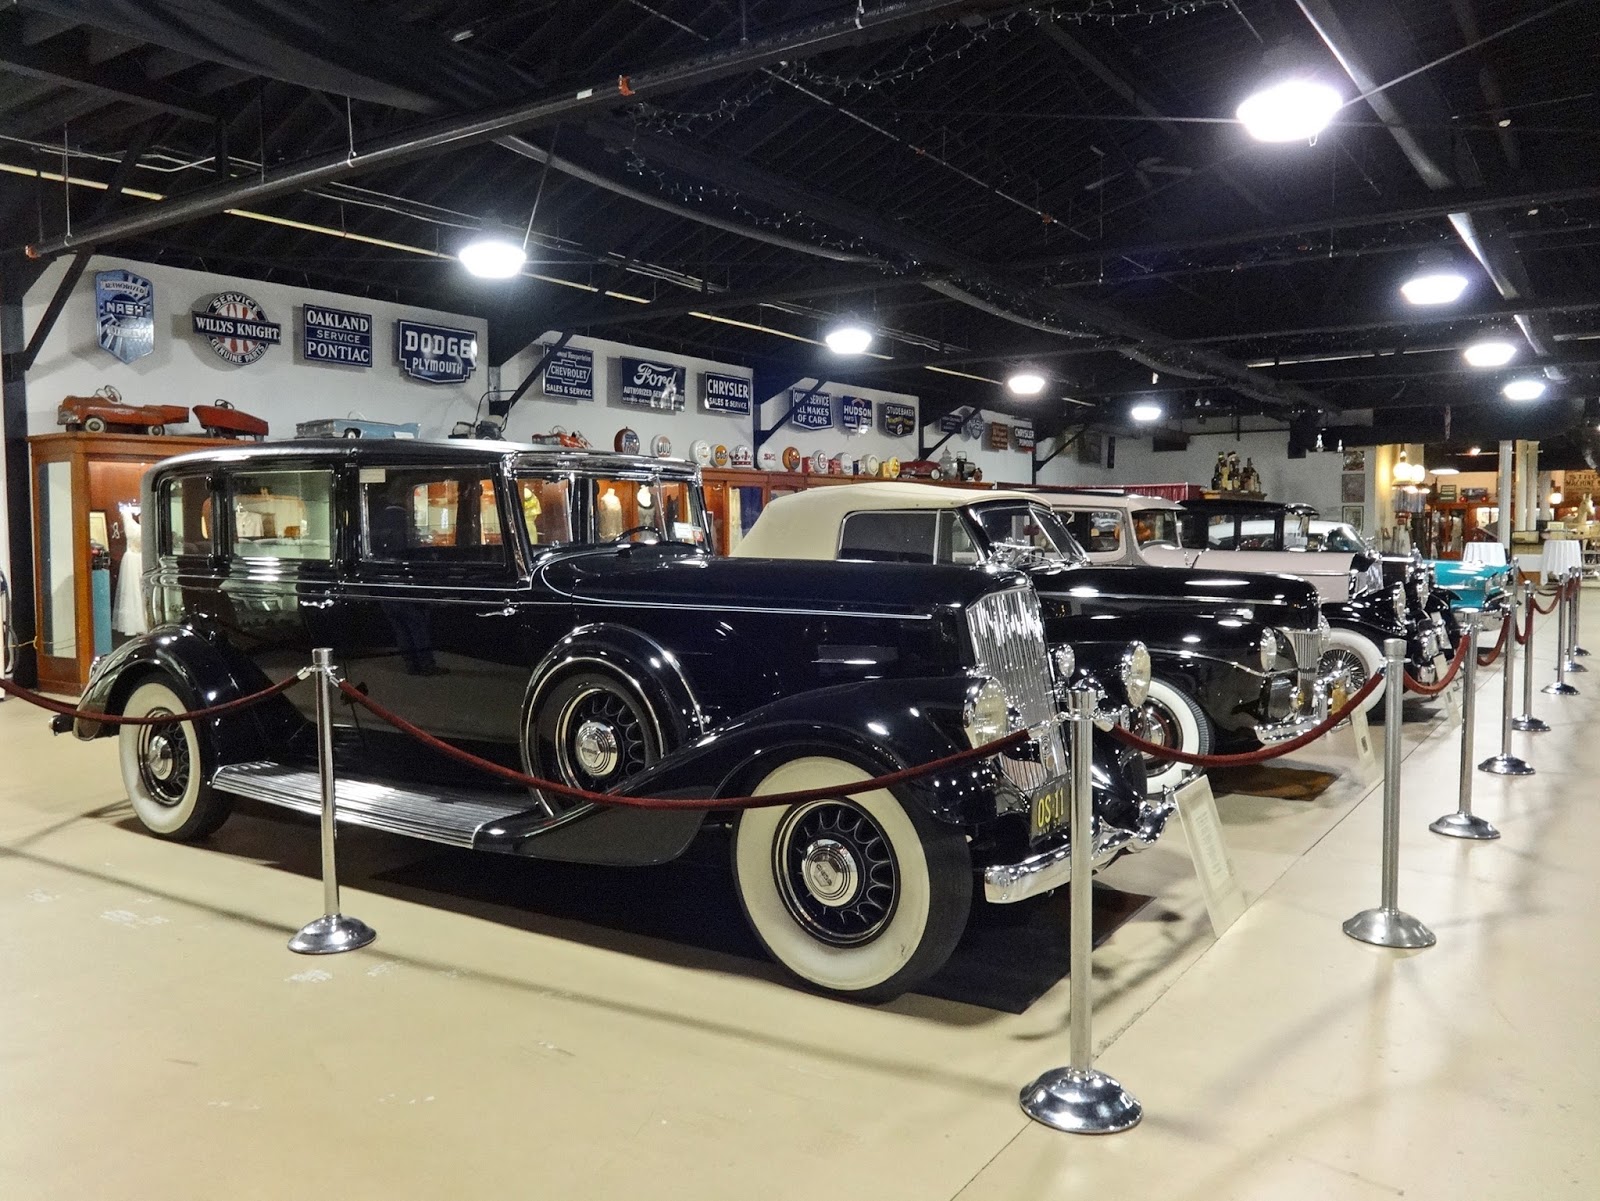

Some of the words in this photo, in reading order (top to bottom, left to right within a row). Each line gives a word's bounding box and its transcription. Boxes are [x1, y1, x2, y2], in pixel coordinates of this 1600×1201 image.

[106, 301, 144, 317] NASH
[213, 294, 258, 312] SERVICE
[196, 316, 234, 334] WILLYS
[237, 323, 279, 340] KNIGHT
[307, 310, 369, 332] OAKLAND
[316, 329, 360, 344] SERVICE
[211, 338, 243, 363] GENUINE
[244, 344, 265, 363] PARTS
[307, 341, 369, 362] PONTIAC
[405, 330, 473, 359] DODGE
[412, 357, 463, 375] PLYMOUTH
[550, 365, 588, 380] CHEVROLET
[633, 363, 677, 387] Ford
[546, 384, 563, 393] SALES
[564, 386, 569, 394] &
[569, 387, 592, 397] SERVICE
[623, 386, 652, 397] AUTHORIZED
[707, 379, 749, 399] CHRYSLER
[709, 397, 725, 407] SALES
[730, 400, 748, 410] SERVICE
[806, 406, 830, 416] MAKES
[843, 405, 872, 418] HUDSON
[886, 406, 914, 417] STUDEBAKER
[797, 414, 807, 423] OF
[808, 415, 828, 425] CARS
[1014, 427, 1035, 440] CHRYSLER
